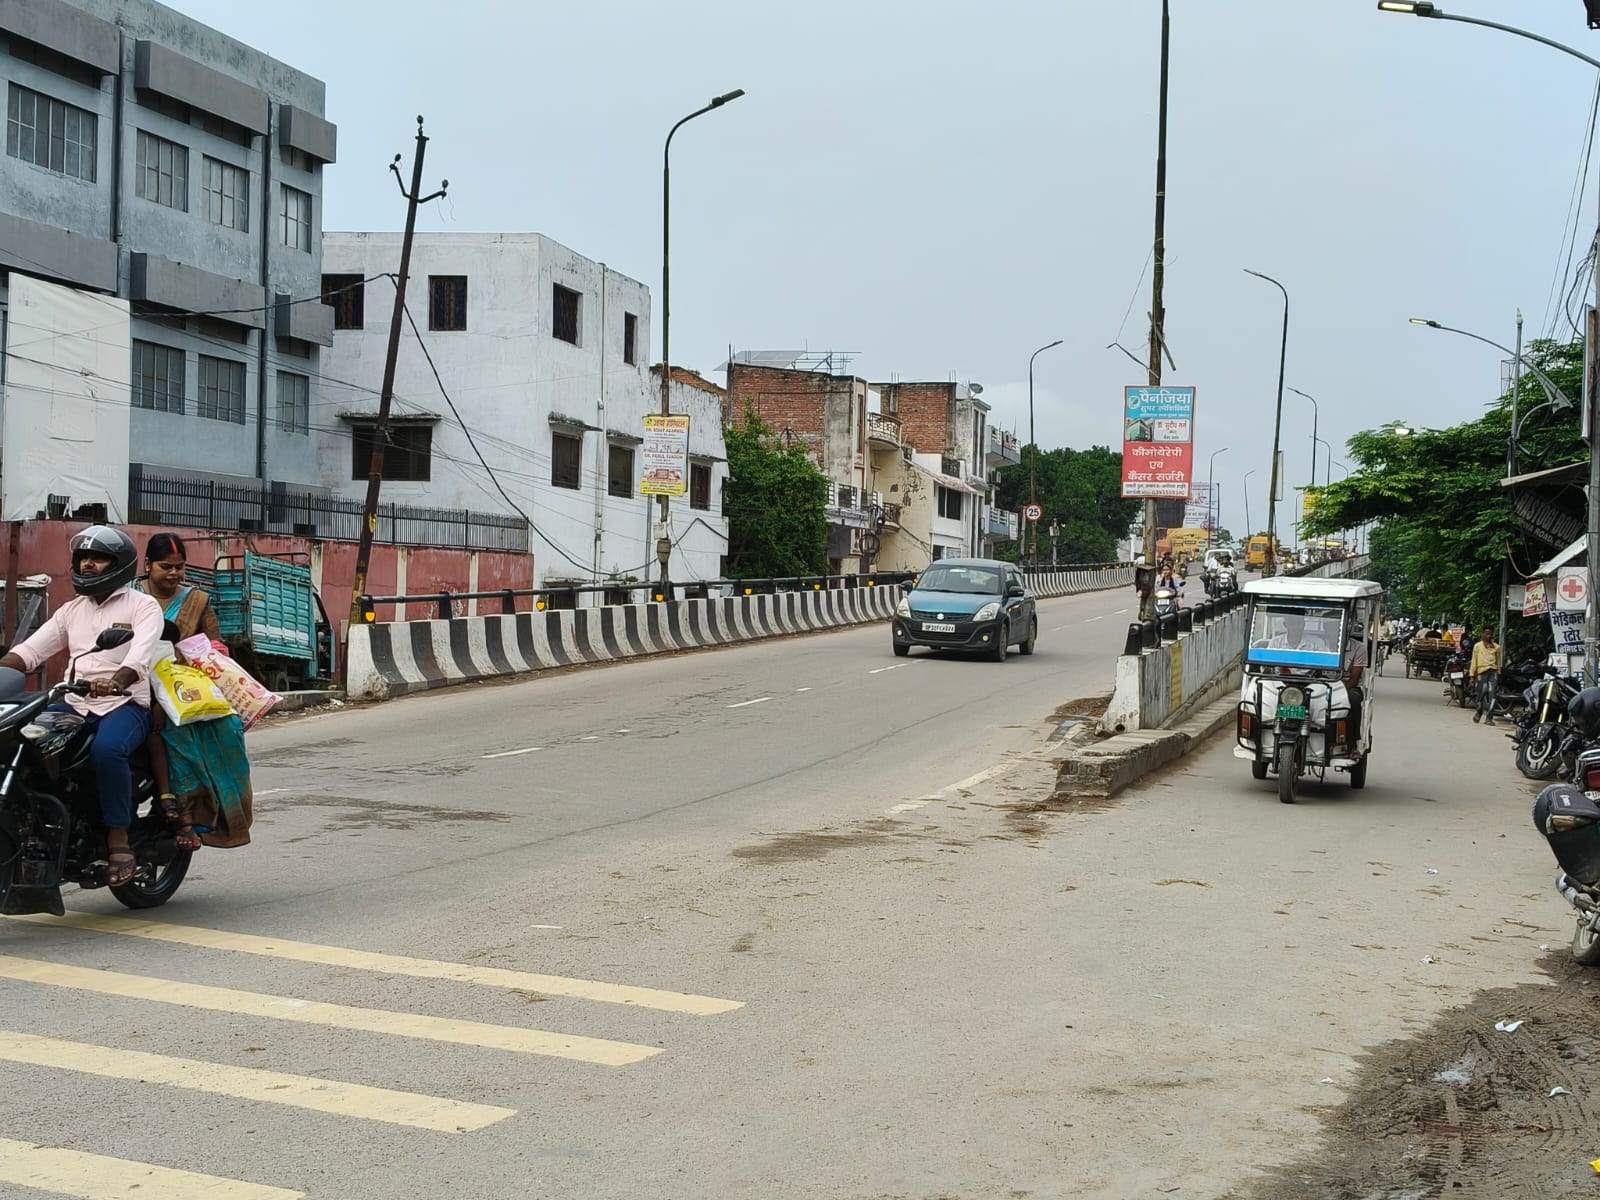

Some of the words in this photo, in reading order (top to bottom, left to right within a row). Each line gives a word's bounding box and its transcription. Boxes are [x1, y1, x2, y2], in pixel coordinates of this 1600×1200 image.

[1139, 389, 1191, 404] पैनजिया
[1132, 446, 1183, 457] कीमोथेरेपी
[1149, 459, 1163, 469] एवं
[1155, 470, 1185, 481] सर्जरी
[1028, 508, 1040, 517] 25
[1551, 512, 1584, 543] BOOK
[1552, 611, 1586, 627] मेडिकल
